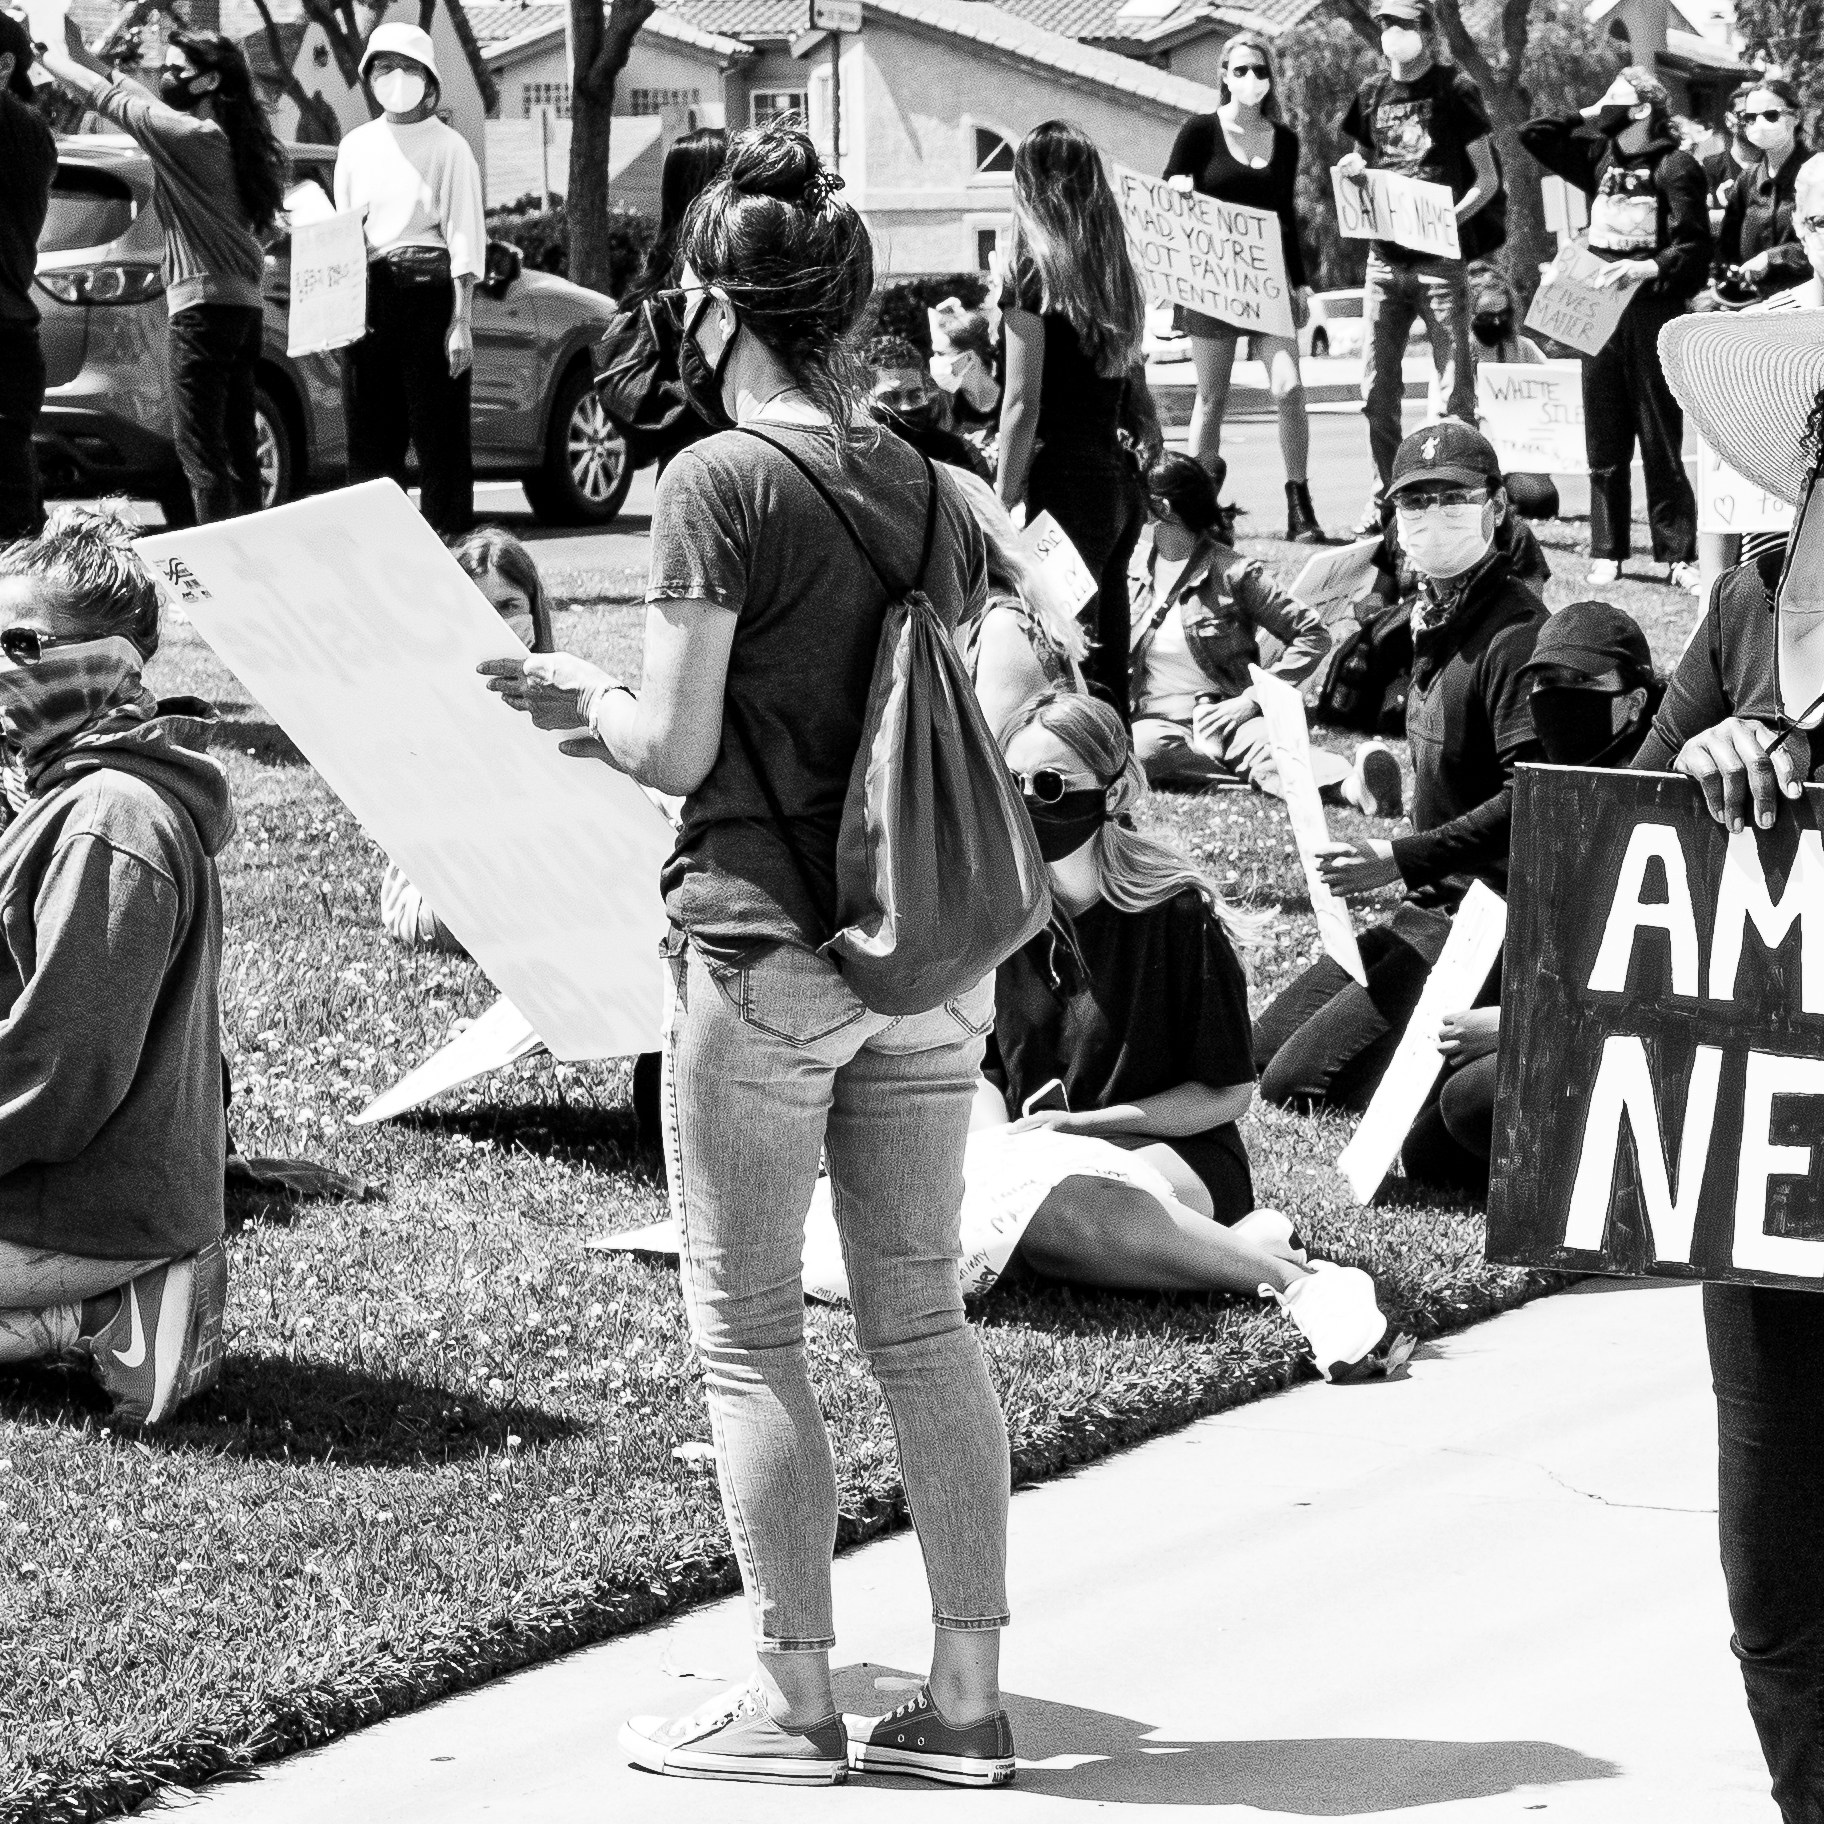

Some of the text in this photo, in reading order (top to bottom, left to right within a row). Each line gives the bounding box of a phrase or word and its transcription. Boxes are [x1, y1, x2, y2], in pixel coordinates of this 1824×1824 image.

[1217, 207, 1267, 240] NOT
[1189, 254, 1280, 299] PAYING
[1485, 375, 1560, 401] WHITE
